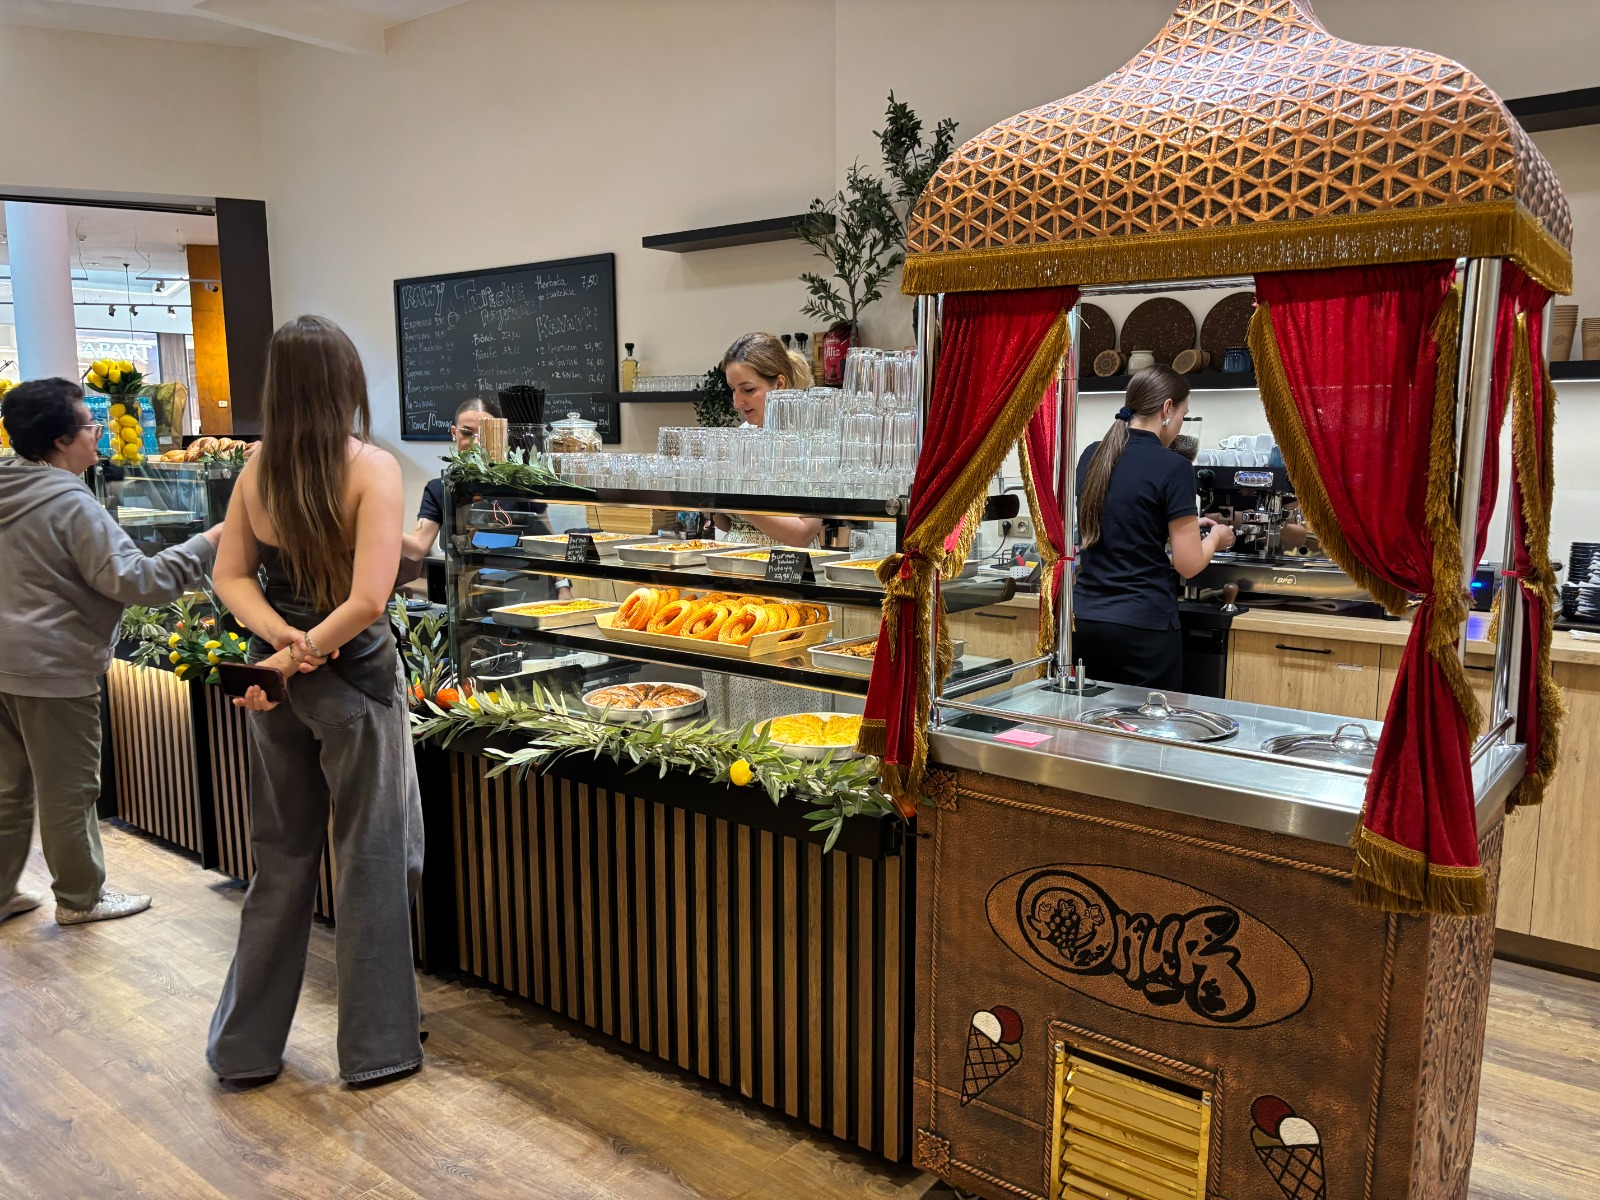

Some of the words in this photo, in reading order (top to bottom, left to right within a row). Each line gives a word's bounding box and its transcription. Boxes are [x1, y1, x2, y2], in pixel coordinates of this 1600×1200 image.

[535, 273, 567, 290] Herbata
[402, 282, 445, 316] KAWY
[403, 317, 432, 332] Espresso
[80, 342, 153, 364] APART
